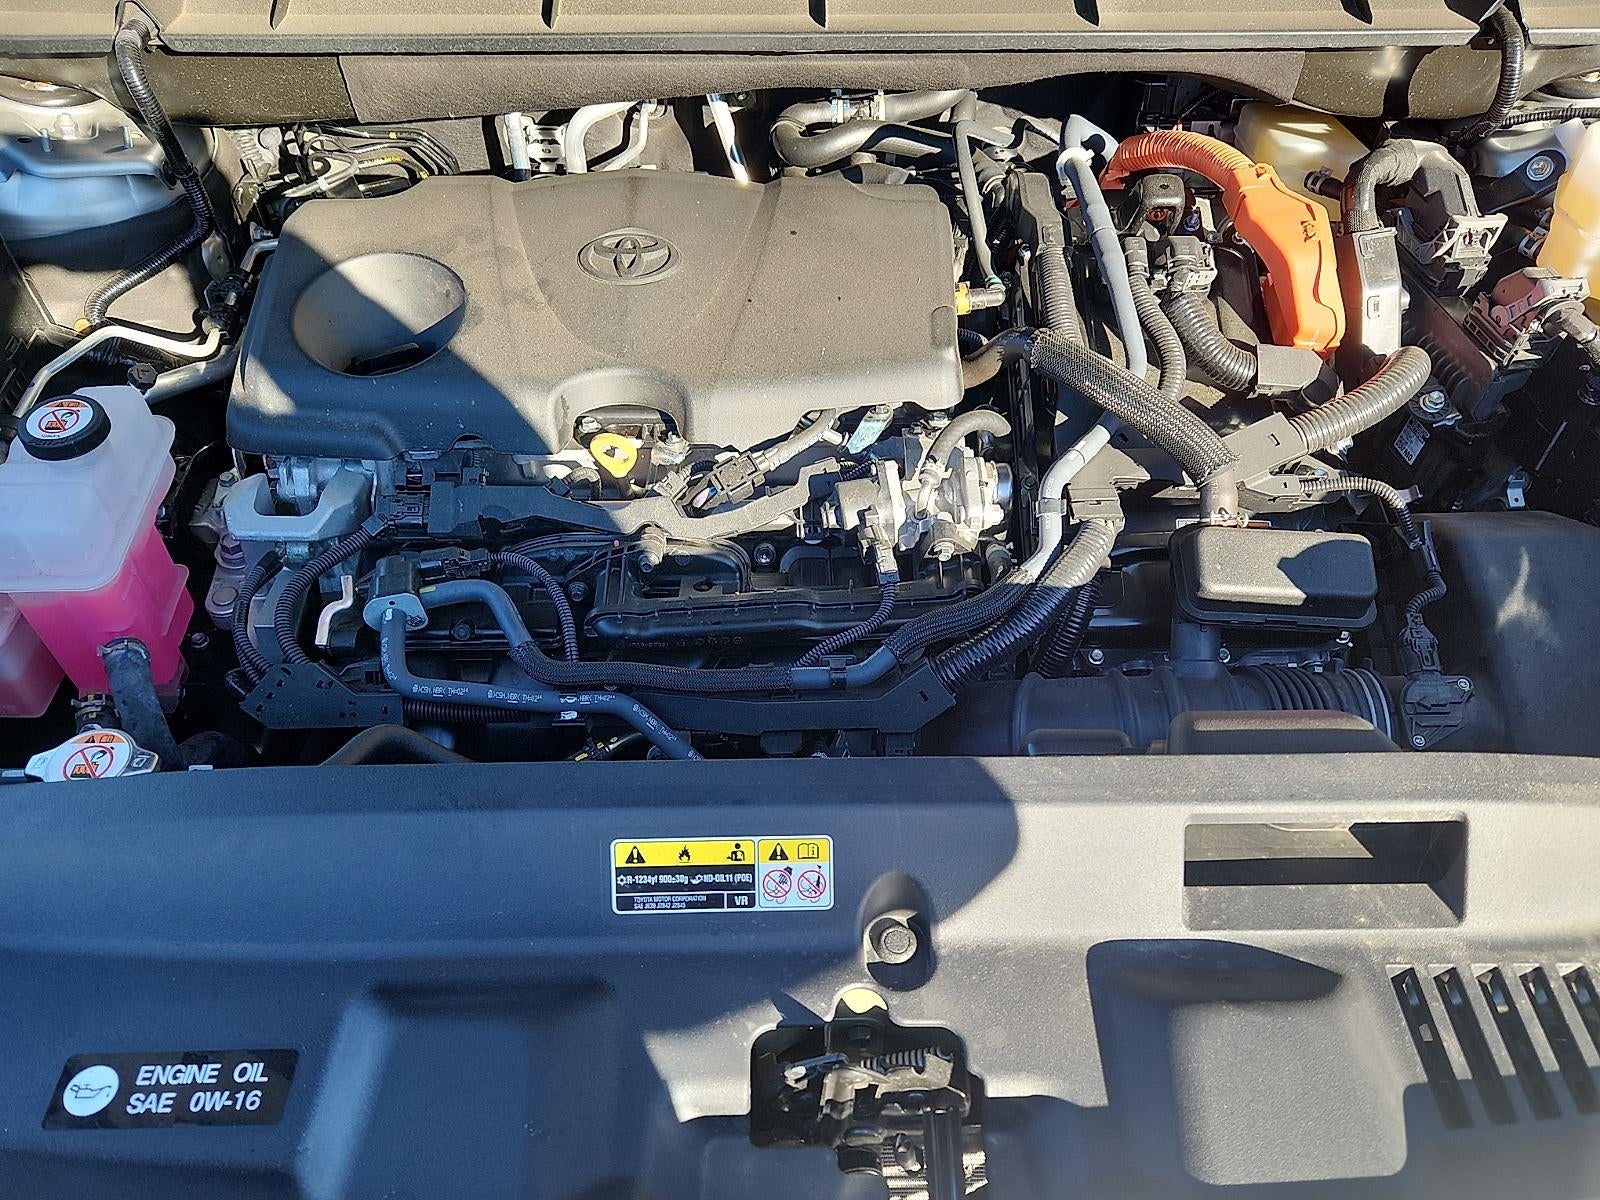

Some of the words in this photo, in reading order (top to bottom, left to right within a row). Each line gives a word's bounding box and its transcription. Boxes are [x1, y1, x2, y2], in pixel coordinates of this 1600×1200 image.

[626, 874, 658, 886] R-1234yf
[734, 873, 753, 884] (POE)
[734, 895, 749, 906] VR
[135, 1063, 222, 1086] ENGINE
[232, 1062, 269, 1083] OIL
[125, 1092, 177, 1115] SAE
[189, 1089, 263, 1113] 0W-16
